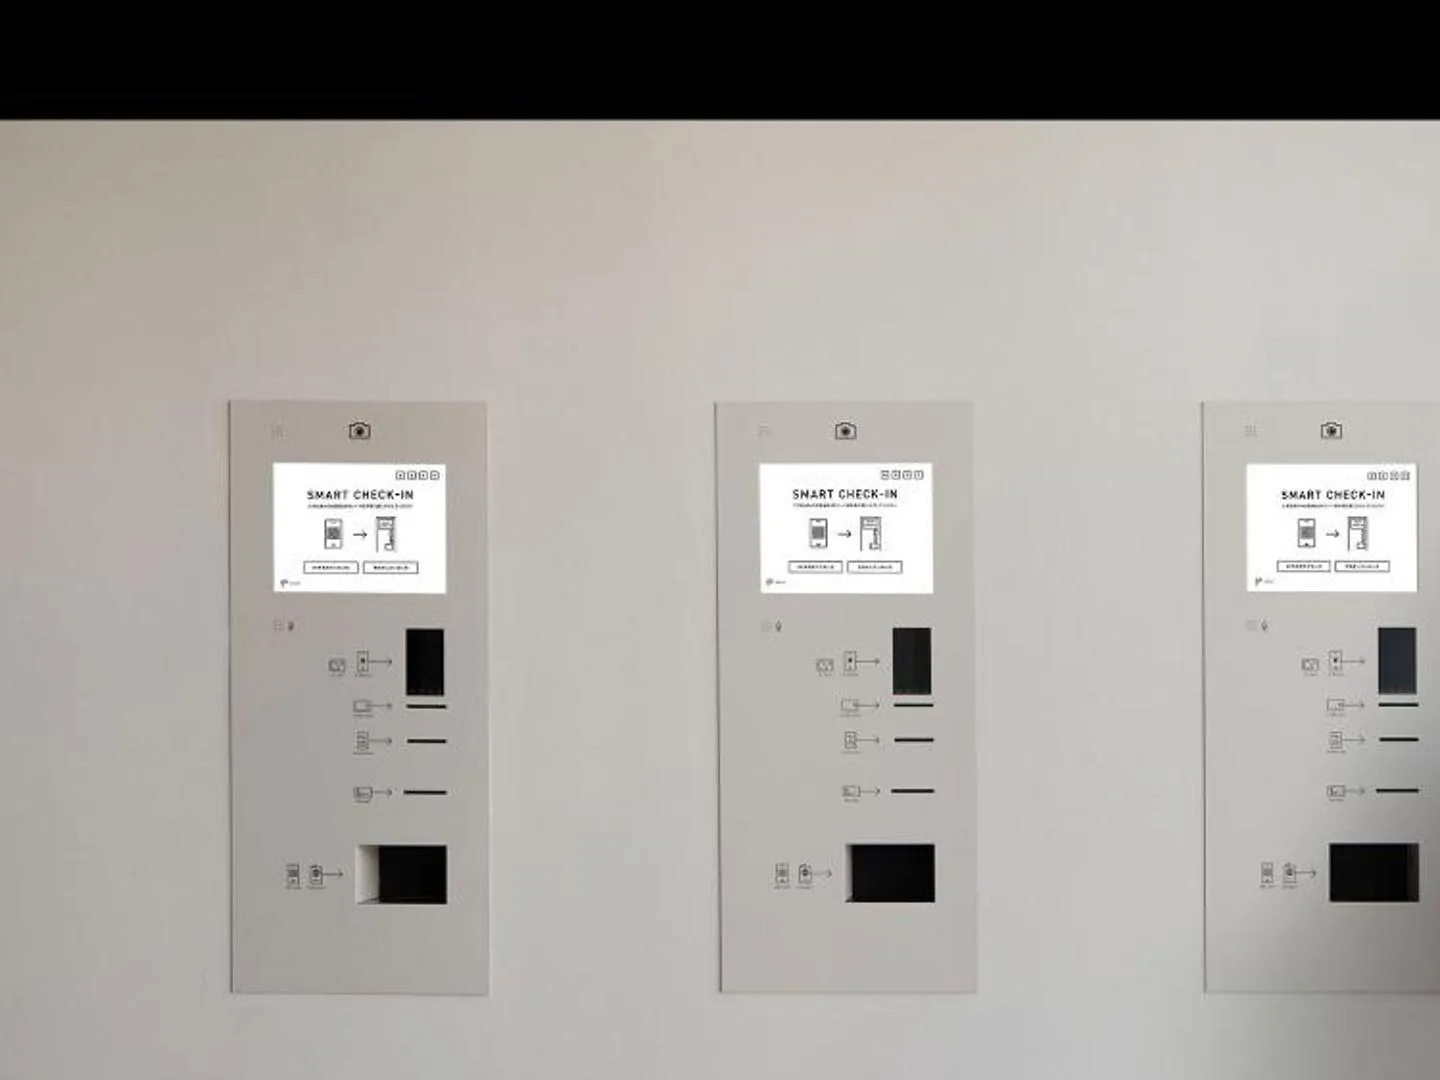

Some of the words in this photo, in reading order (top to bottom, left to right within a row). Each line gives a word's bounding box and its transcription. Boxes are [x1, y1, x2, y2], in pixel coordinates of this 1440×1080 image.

[306, 489, 348, 500] SMART
[353, 489, 414, 500] CHECK-IN
[792, 489, 834, 500] SMART
[838, 489, 898, 500] CHECK-IN
[1281, 489, 1322, 500] SMART
[1326, 489, 1385, 500] CHECK-IN
